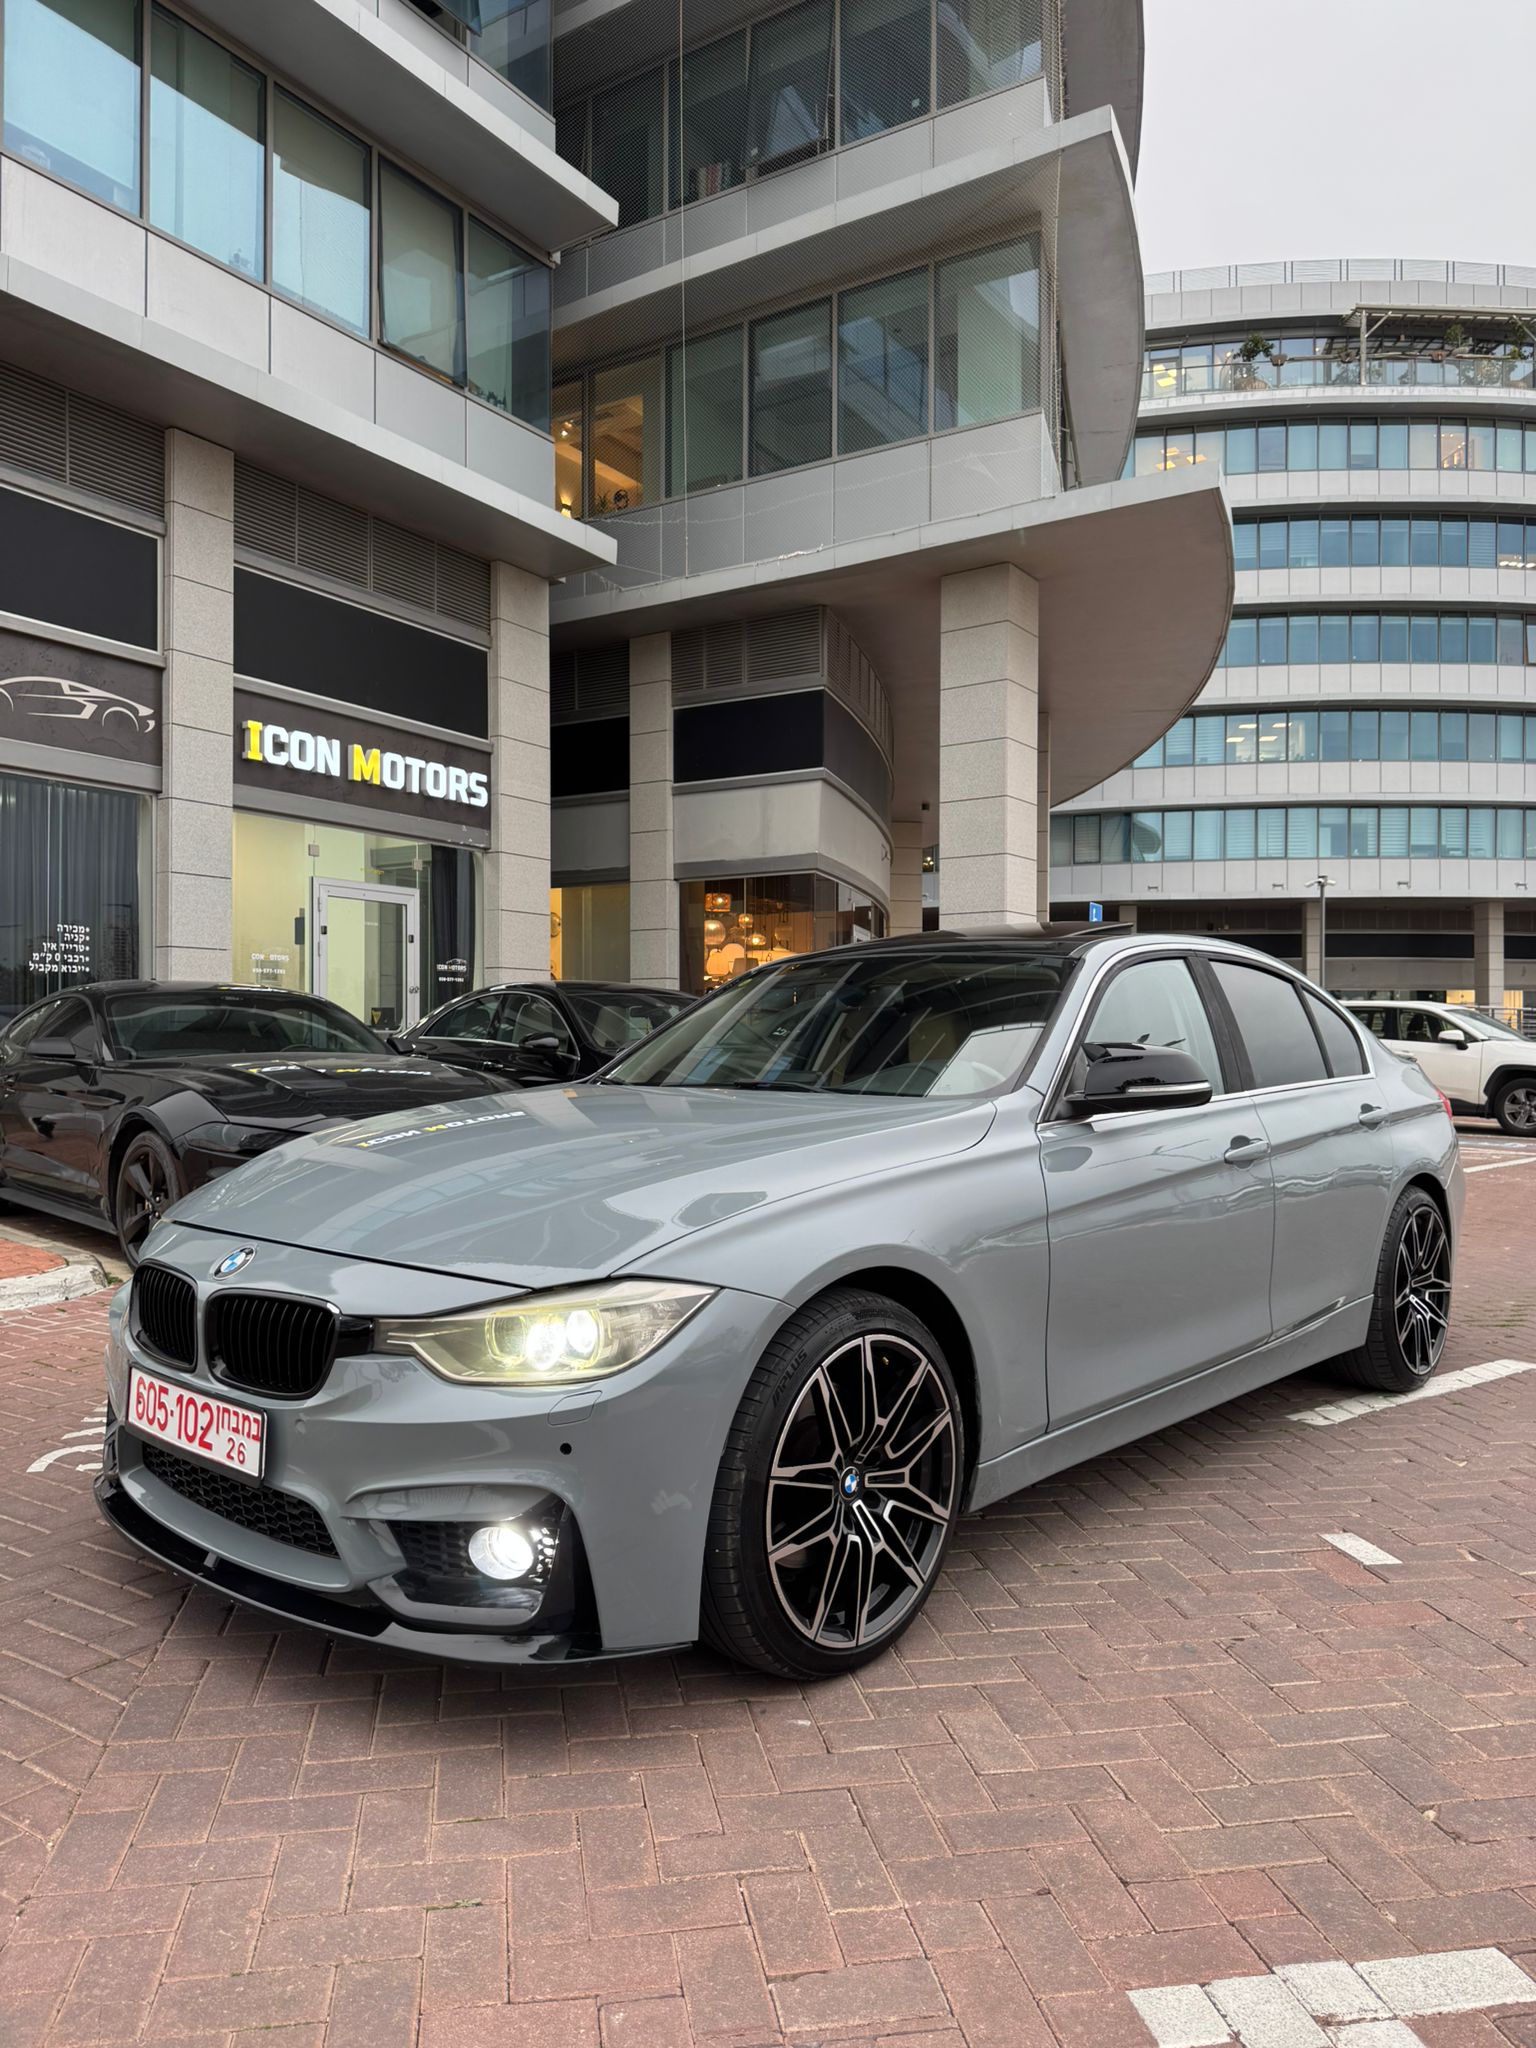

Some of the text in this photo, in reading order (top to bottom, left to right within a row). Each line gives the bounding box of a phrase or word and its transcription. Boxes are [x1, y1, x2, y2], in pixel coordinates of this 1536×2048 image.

[243, 719, 489, 808] ICON MOTORS
[57, 924, 85, 933] מכירה
[64, 933, 85, 944] קניה
[43, 942, 85, 952] טרייד אין
[55, 953, 61, 962] 0
[64, 954, 85, 963] רכבי
[29, 961, 85, 974] ייבוא מקביל
[216, 1405, 261, 1442] במבחן
[226, 1437, 246, 1465] 26
